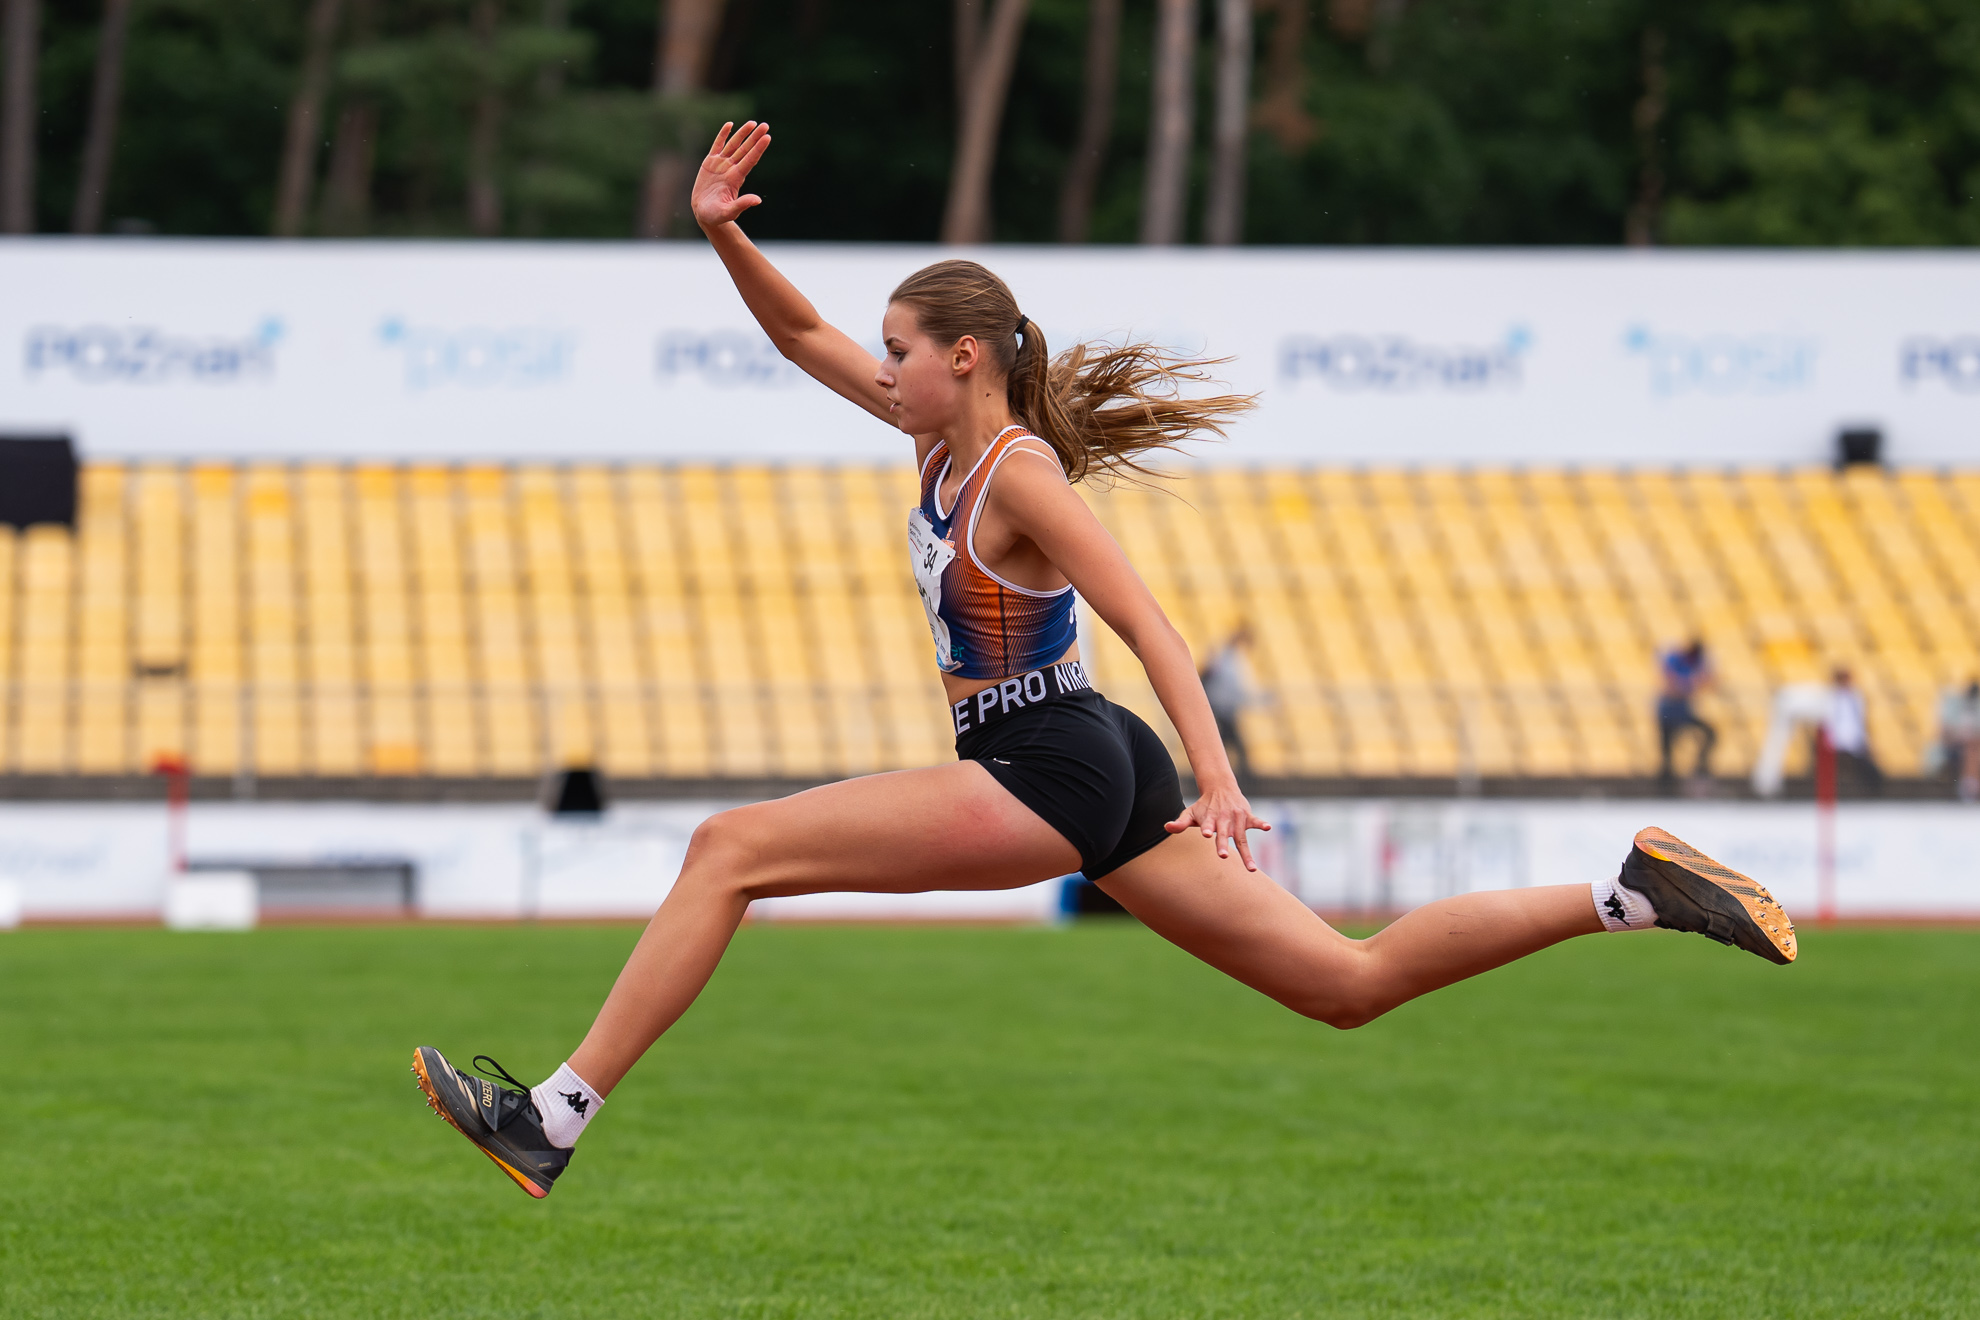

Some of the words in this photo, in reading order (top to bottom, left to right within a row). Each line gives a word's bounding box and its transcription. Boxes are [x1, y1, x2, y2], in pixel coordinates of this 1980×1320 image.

[1899, 332, 1980, 394] PO
[923, 542, 938, 575] 34
[977, 670, 1047, 724] PRO
